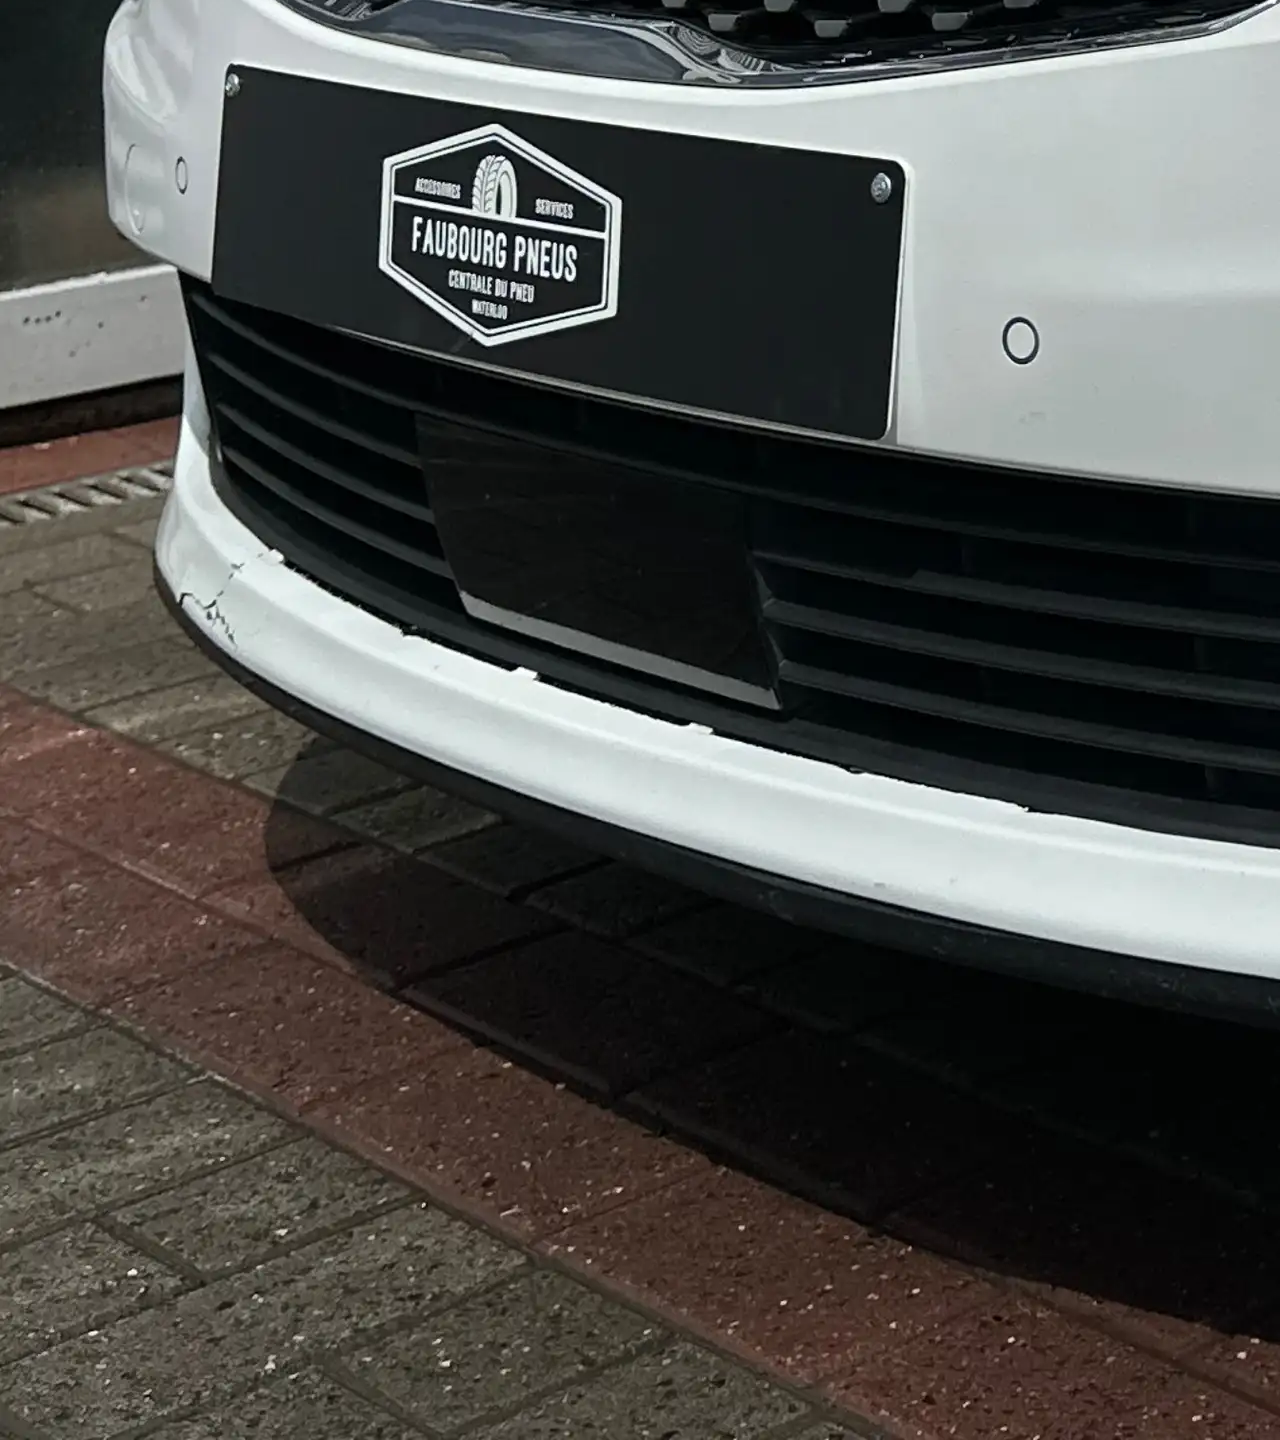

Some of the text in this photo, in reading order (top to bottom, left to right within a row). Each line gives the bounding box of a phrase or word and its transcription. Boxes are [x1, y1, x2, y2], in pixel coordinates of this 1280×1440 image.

[535, 198, 575, 220] SERVICES
[411, 215, 578, 283] FAUBOURG PNEUS
[448, 269, 535, 303] CENTRALE DU PNEU
